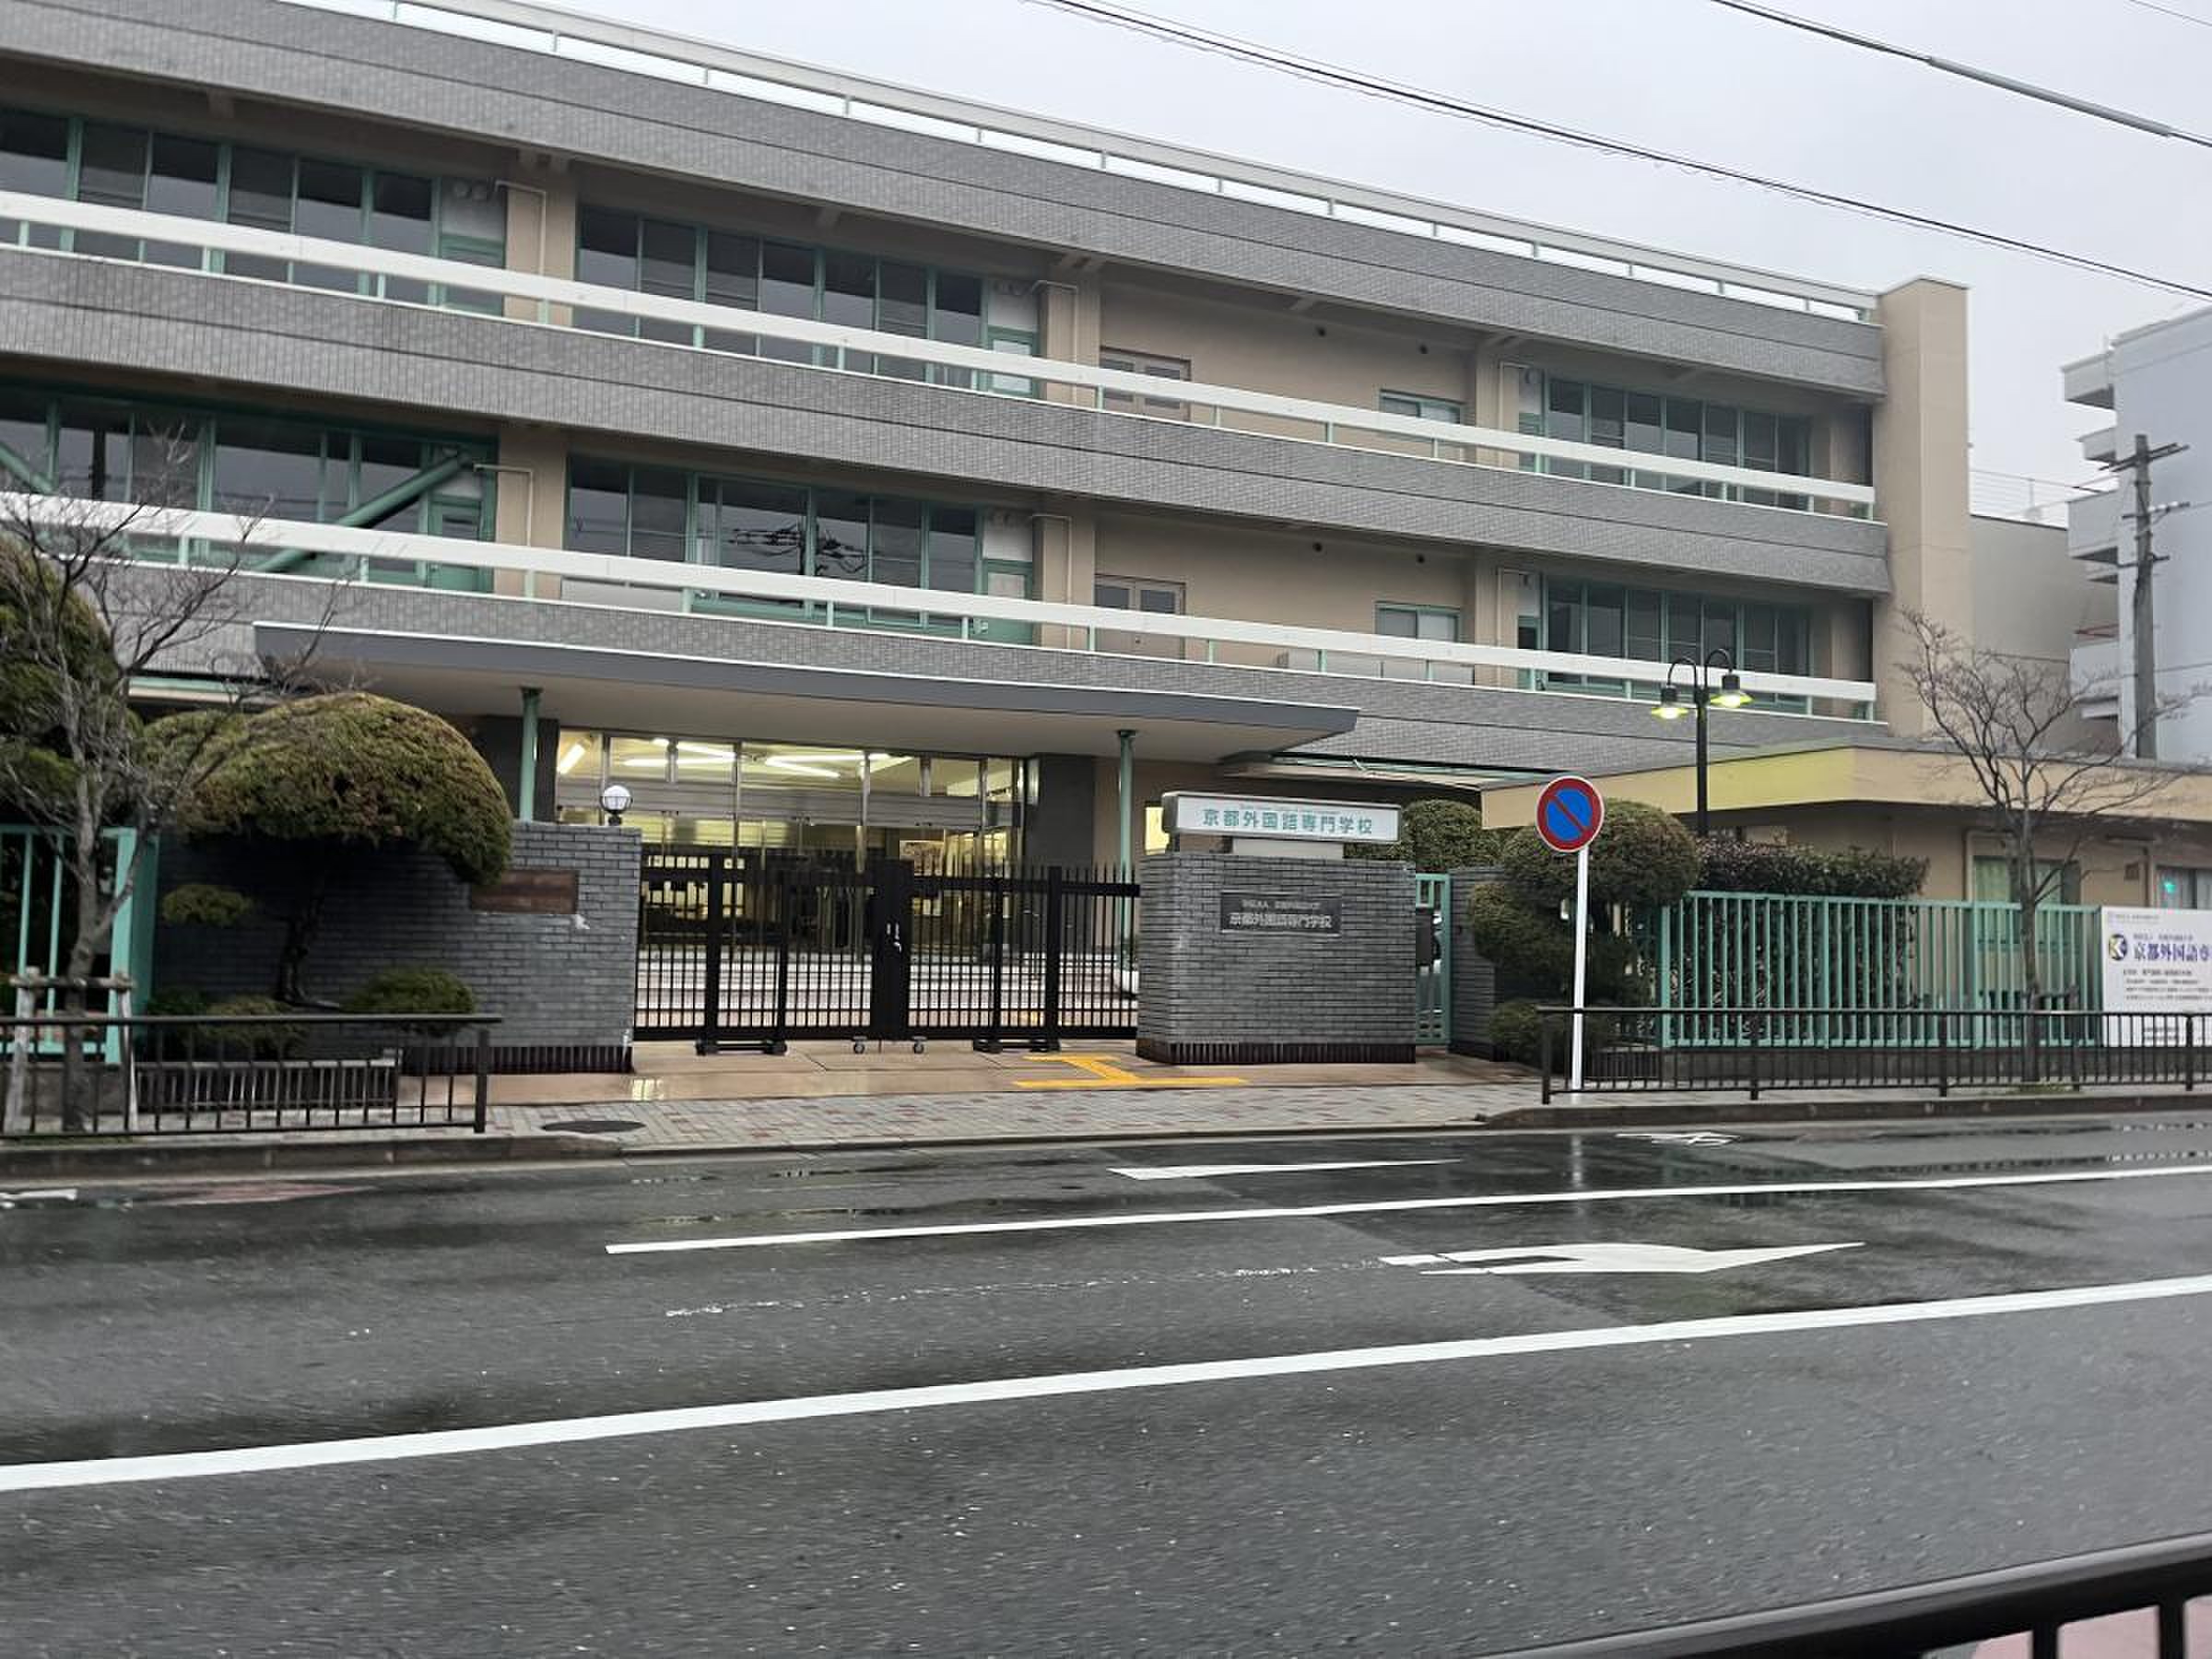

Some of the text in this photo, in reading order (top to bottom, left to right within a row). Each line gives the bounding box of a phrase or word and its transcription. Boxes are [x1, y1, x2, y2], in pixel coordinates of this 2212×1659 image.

[1203, 808, 1373, 835] 京都外国語専門学校
